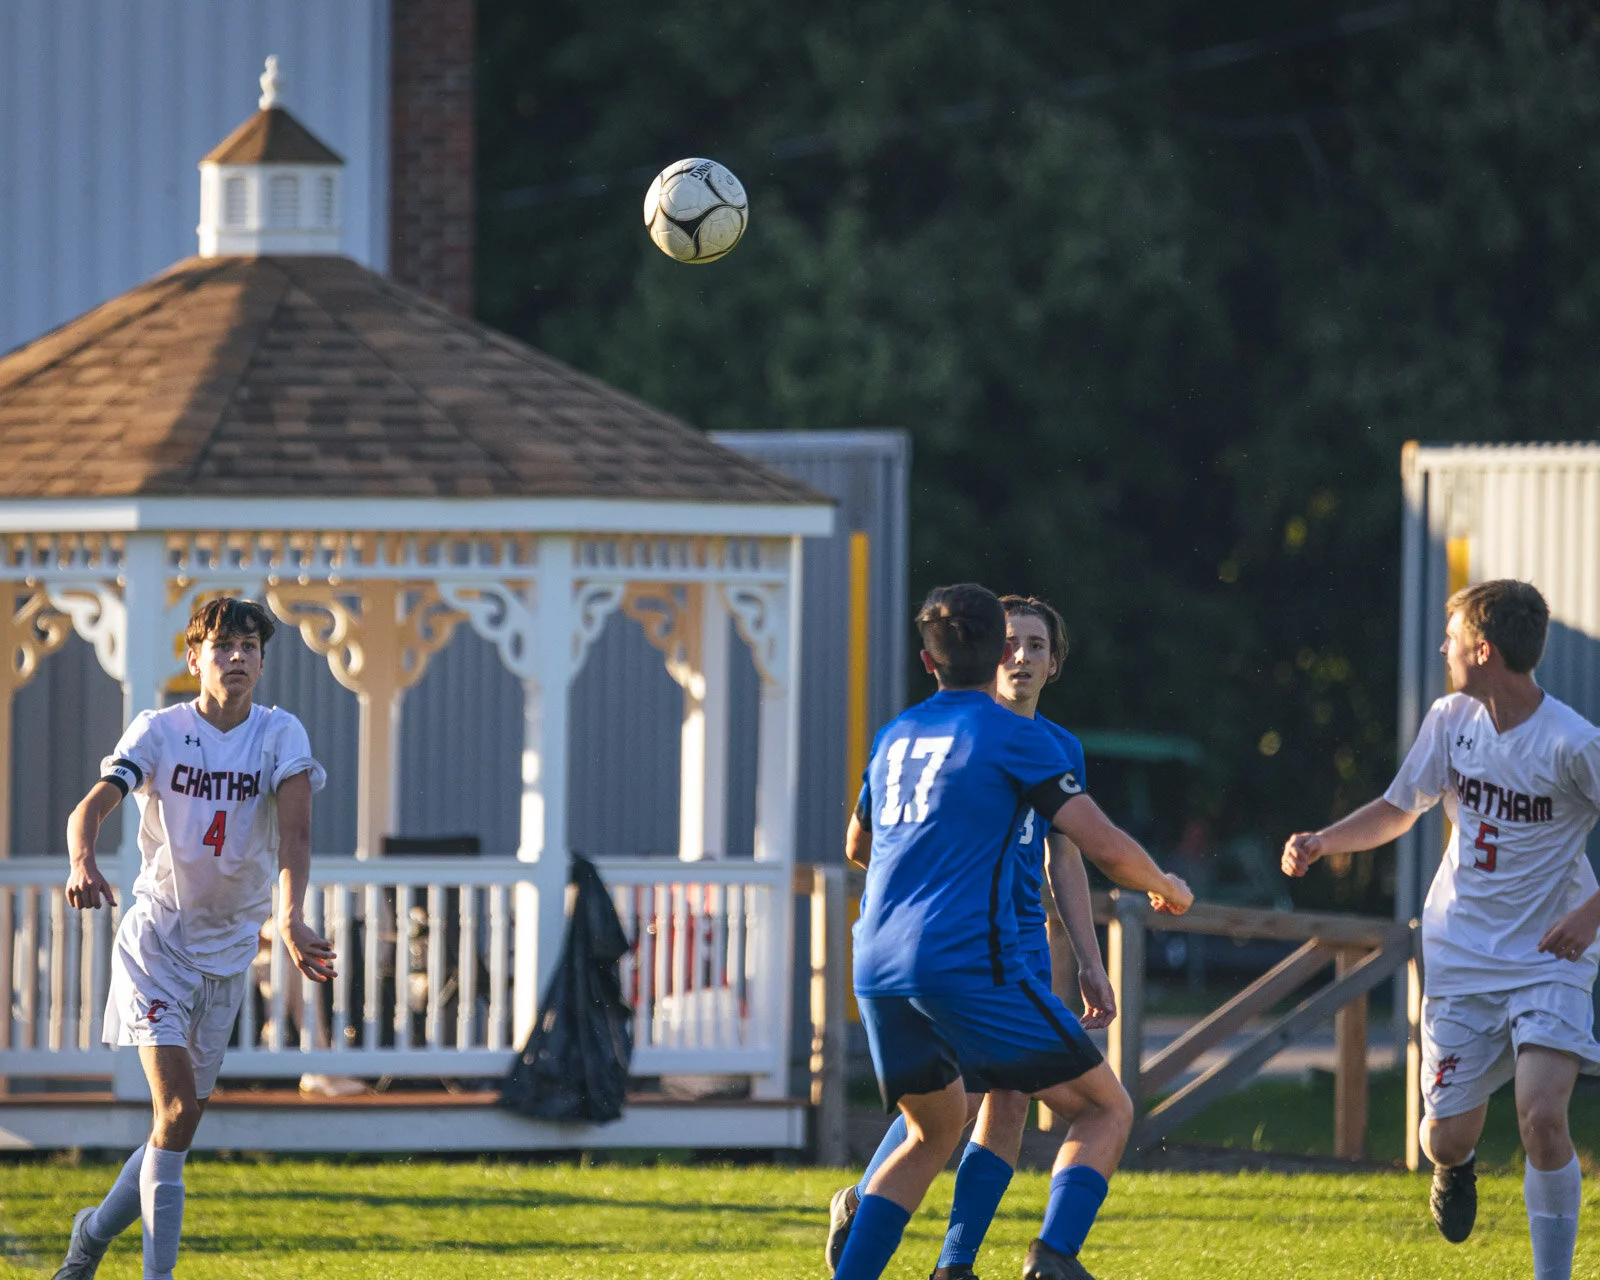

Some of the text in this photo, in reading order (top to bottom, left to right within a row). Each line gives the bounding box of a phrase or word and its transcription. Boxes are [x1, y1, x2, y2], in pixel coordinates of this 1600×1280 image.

[880, 736, 954, 826] 17
[1058, 773, 1082, 794] C
[203, 811, 227, 857] 4
[1473, 821, 1499, 873] 5
